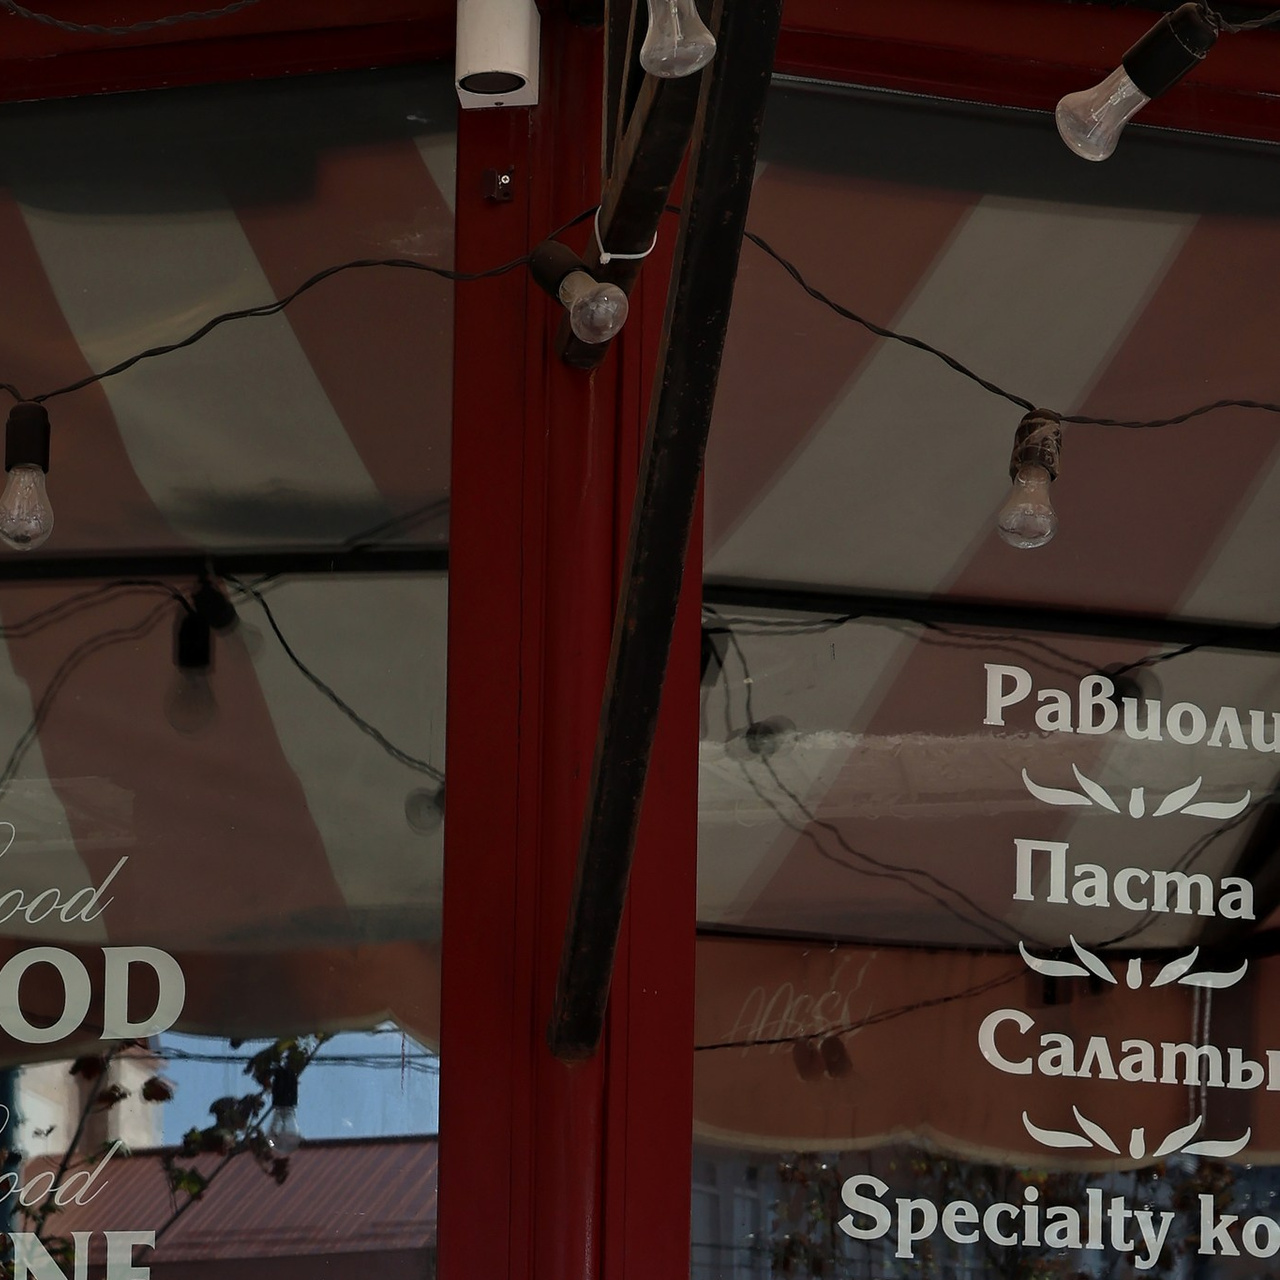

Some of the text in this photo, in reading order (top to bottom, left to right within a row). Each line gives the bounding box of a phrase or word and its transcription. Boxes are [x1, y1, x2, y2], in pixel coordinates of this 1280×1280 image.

[1012, 838, 1256, 921] Паста
[978, 1009, 1280, 1092] Салаты
[837, 1174, 1176, 1270] Specialty
